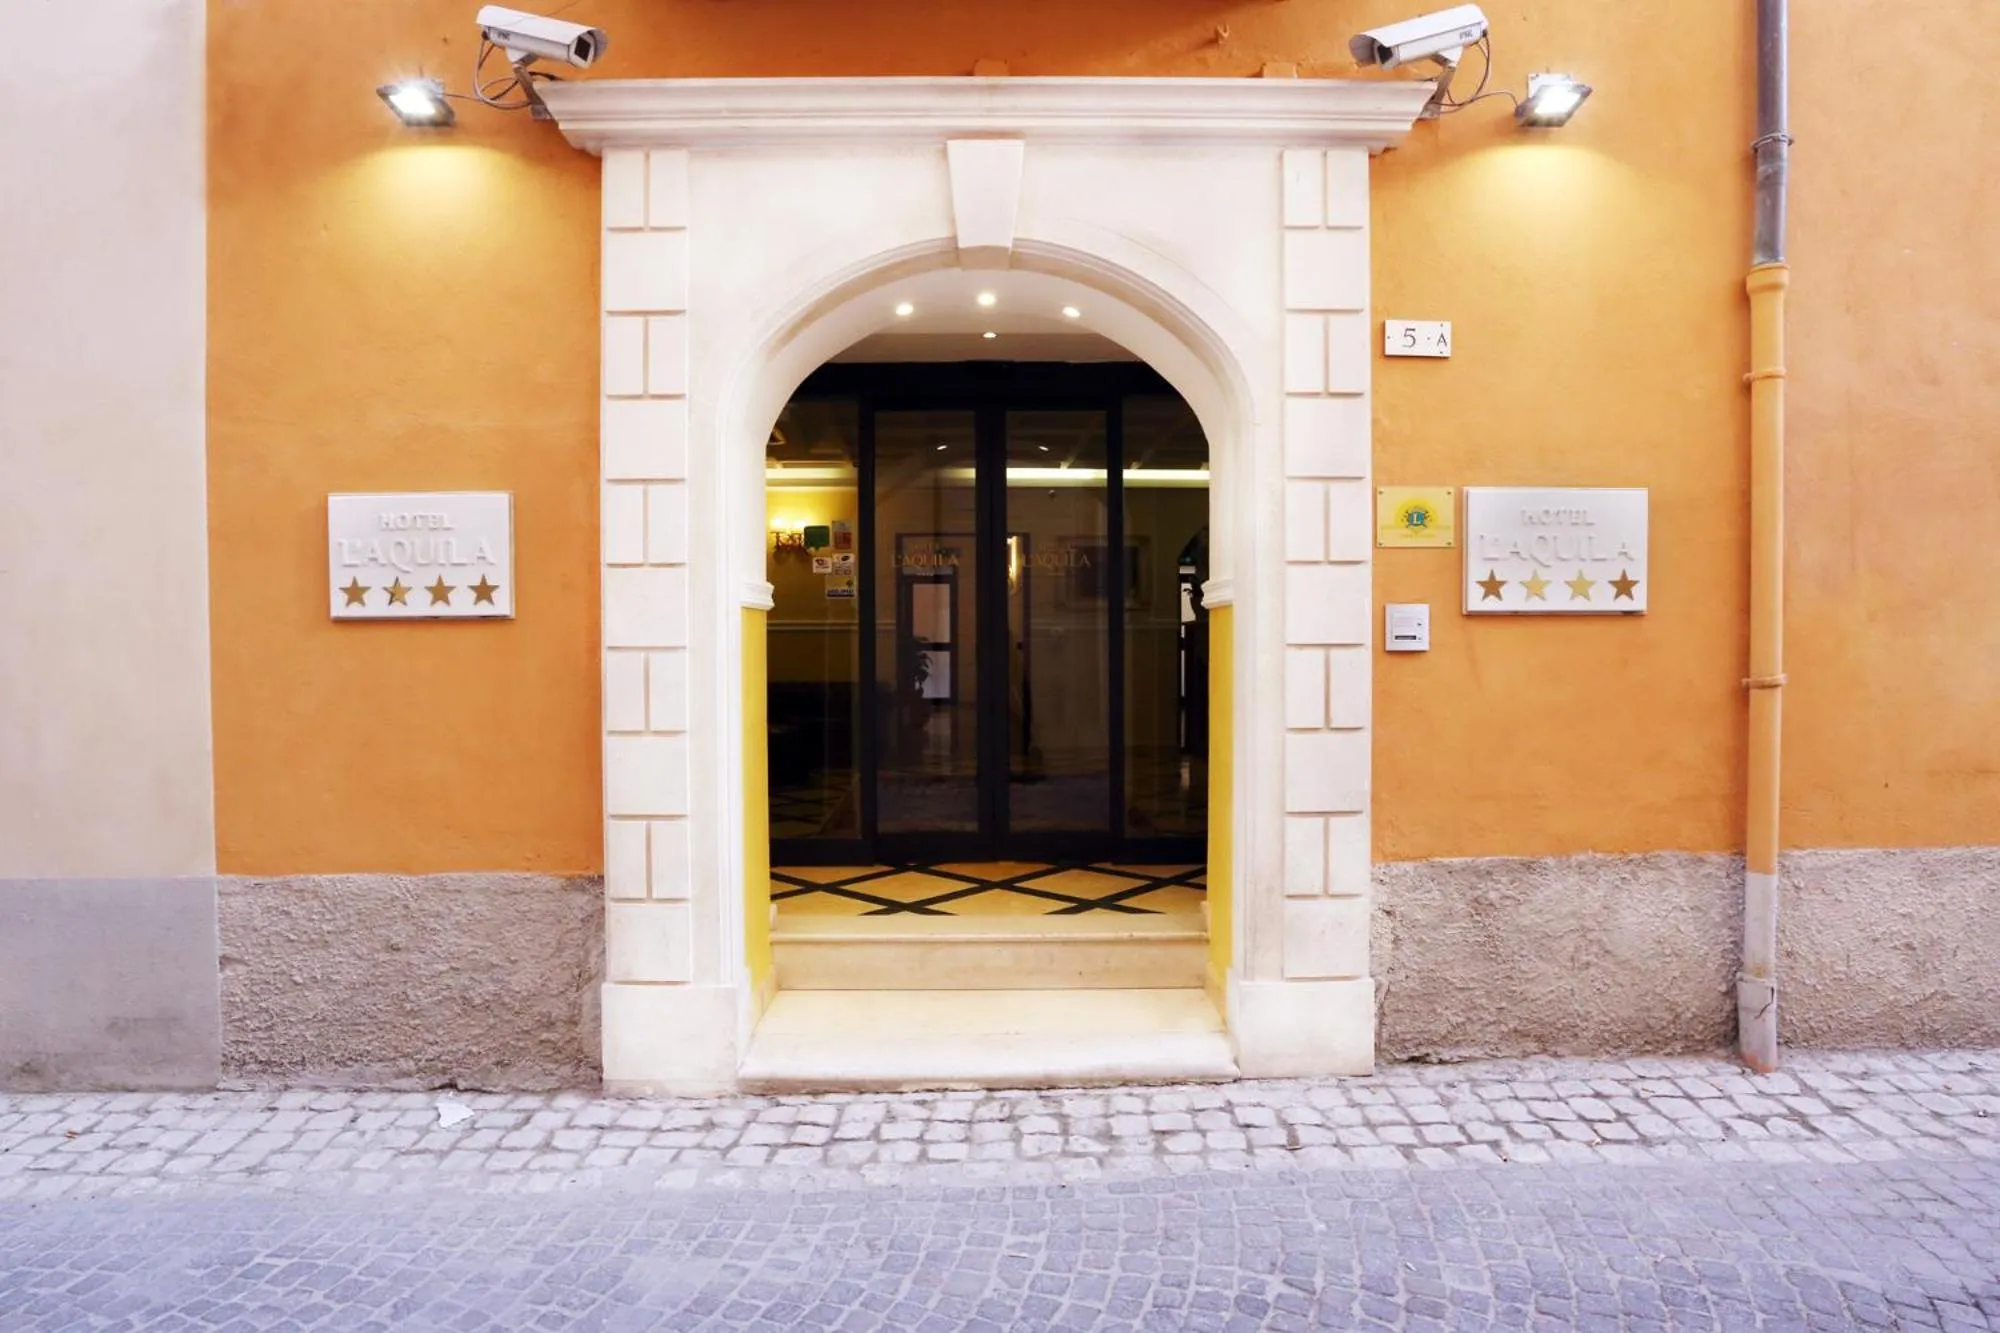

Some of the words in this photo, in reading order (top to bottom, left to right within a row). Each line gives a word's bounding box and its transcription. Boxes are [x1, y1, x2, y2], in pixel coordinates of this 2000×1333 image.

[1402, 327, 1417, 348] 5
[1436, 333, 1448, 347] A
[378, 512, 457, 532] HOTEL
[1521, 508, 1596, 527] HOTEL
[338, 537, 497, 574] L'AQUILA
[1479, 533, 1635, 568] L'AQUILA
